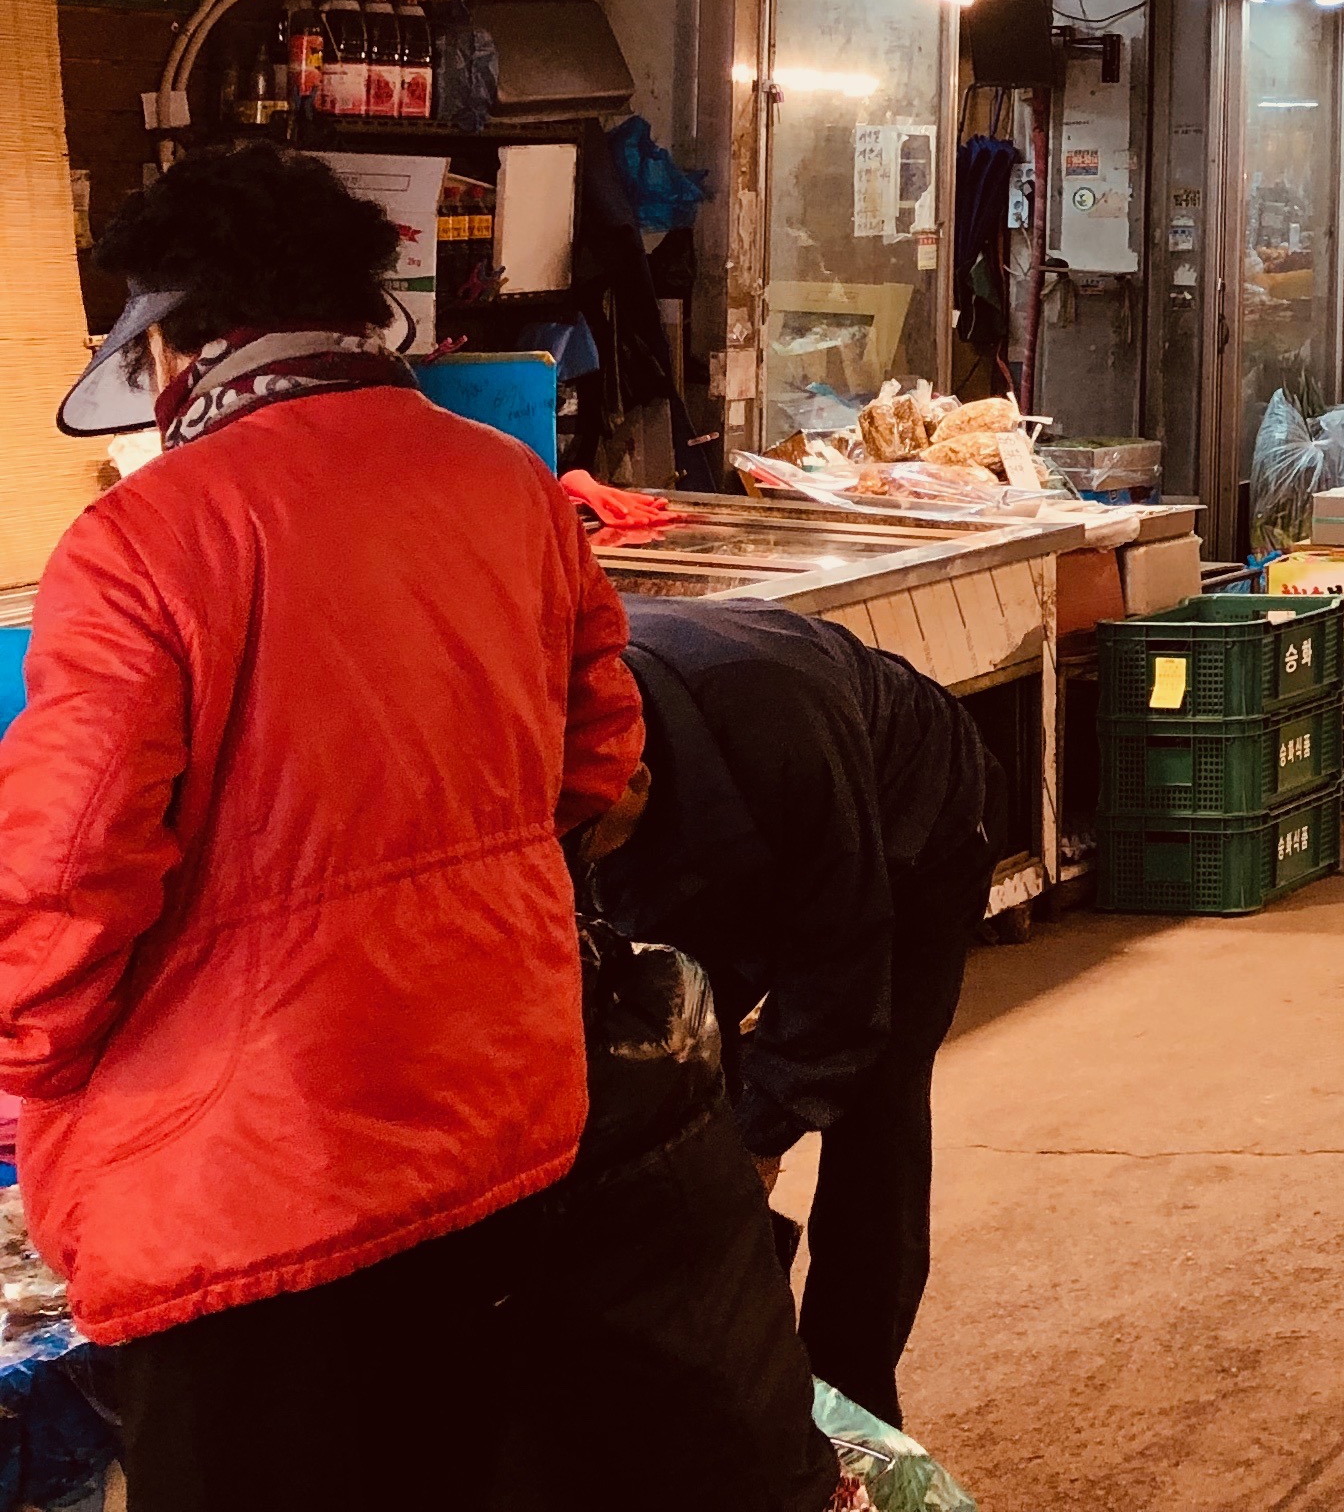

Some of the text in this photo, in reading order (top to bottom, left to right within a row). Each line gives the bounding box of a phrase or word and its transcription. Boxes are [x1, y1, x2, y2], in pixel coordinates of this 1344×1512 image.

[1284, 637, 1314, 674] 승화
[1278, 734, 1311, 768] 승화식품
[1277, 825, 1310, 861] 승화식품
